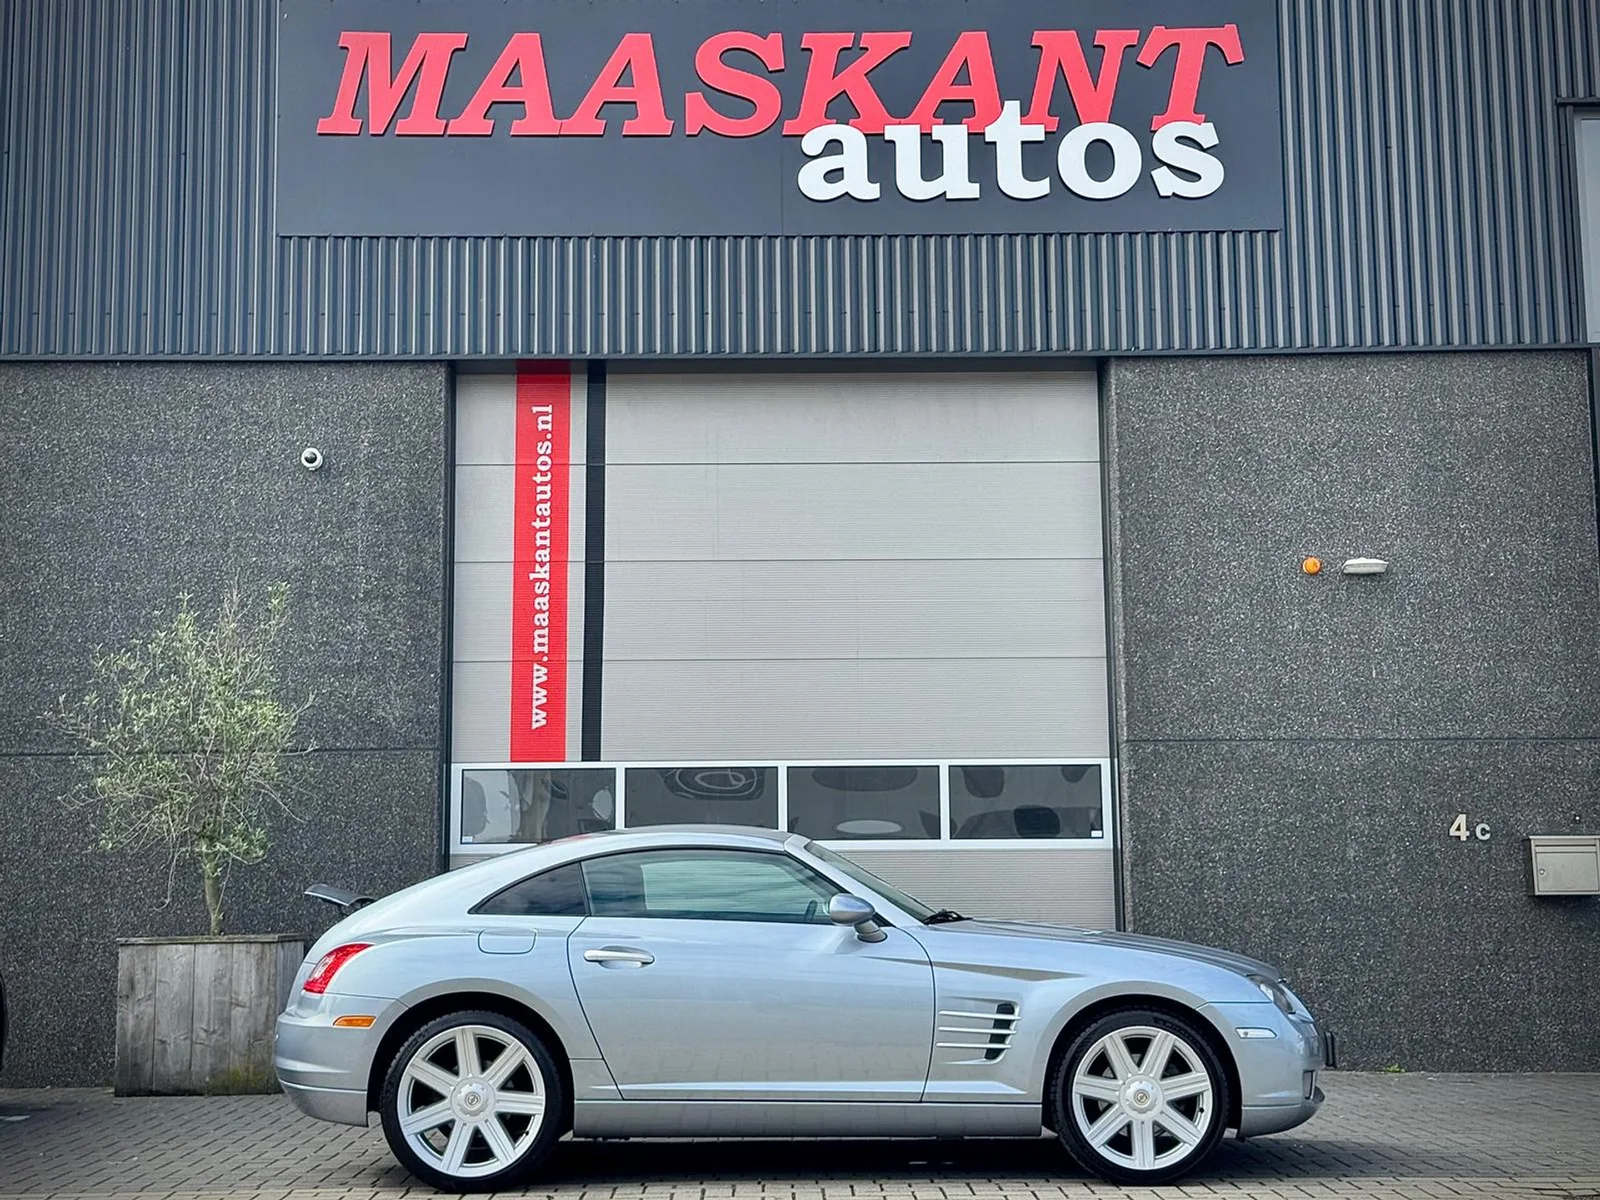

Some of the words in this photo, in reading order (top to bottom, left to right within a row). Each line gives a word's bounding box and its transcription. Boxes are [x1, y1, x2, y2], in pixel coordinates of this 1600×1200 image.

[317, 24, 1244, 137] MAASKANT
[798, 100, 1224, 201] autos
[528, 404, 553, 730] www.maaskantautos.nl
